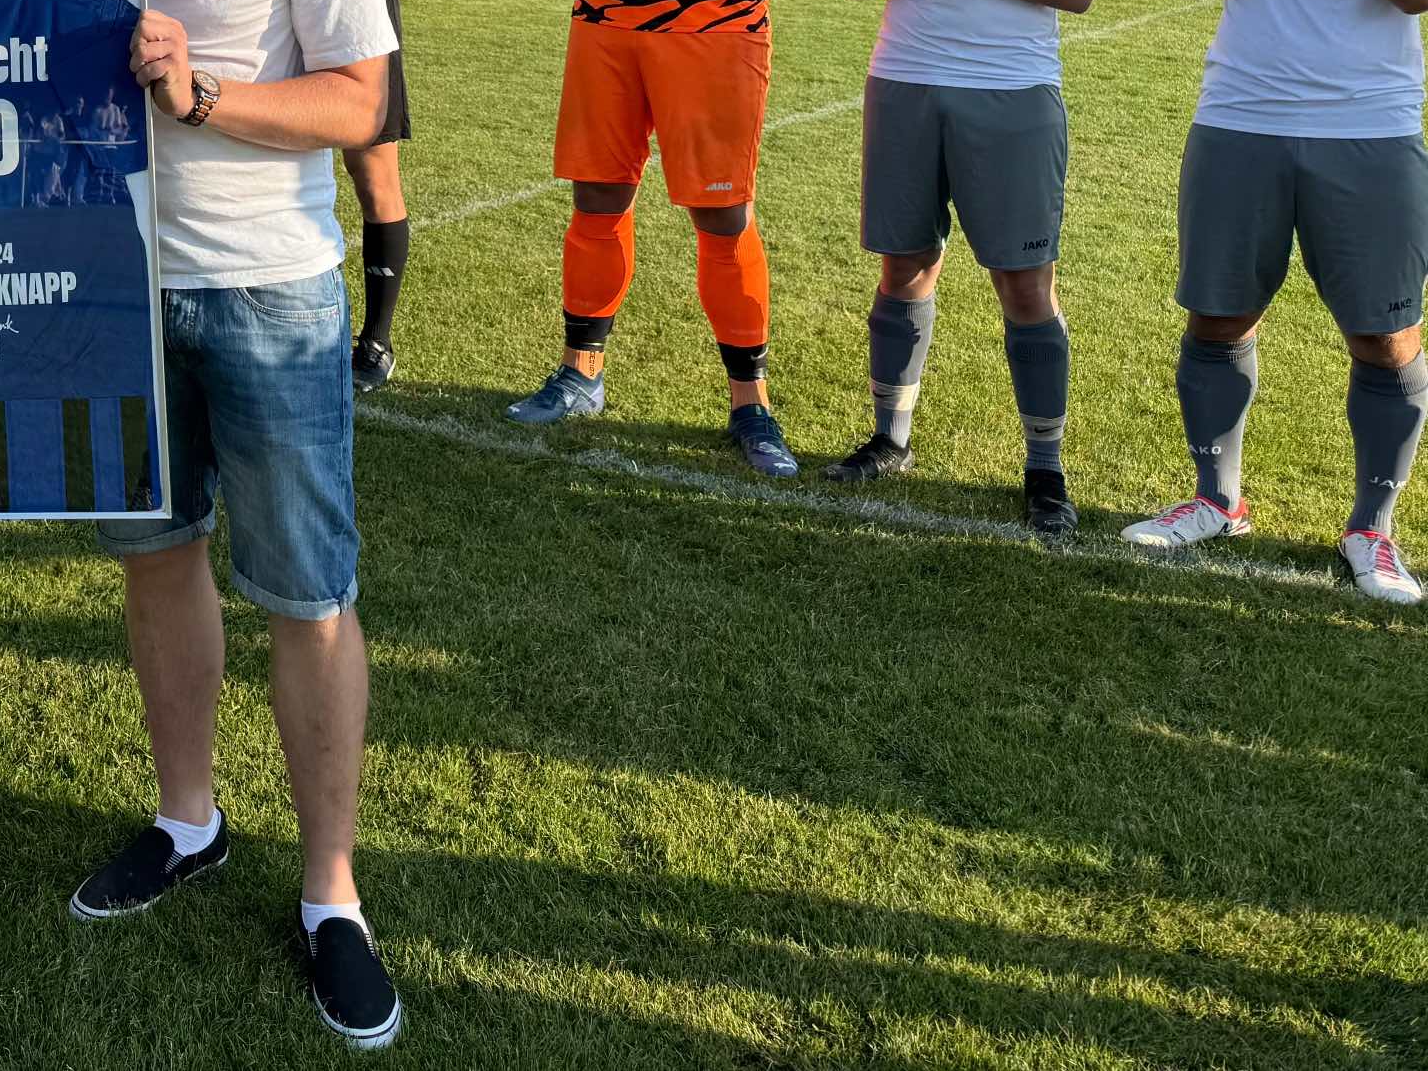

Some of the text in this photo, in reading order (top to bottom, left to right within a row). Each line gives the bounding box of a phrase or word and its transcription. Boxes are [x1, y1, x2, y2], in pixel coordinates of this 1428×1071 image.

[1022, 239, 1049, 251] JAKO
[1387, 298, 1412, 314] JAKO
[1188, 444, 1222, 455] AKO
